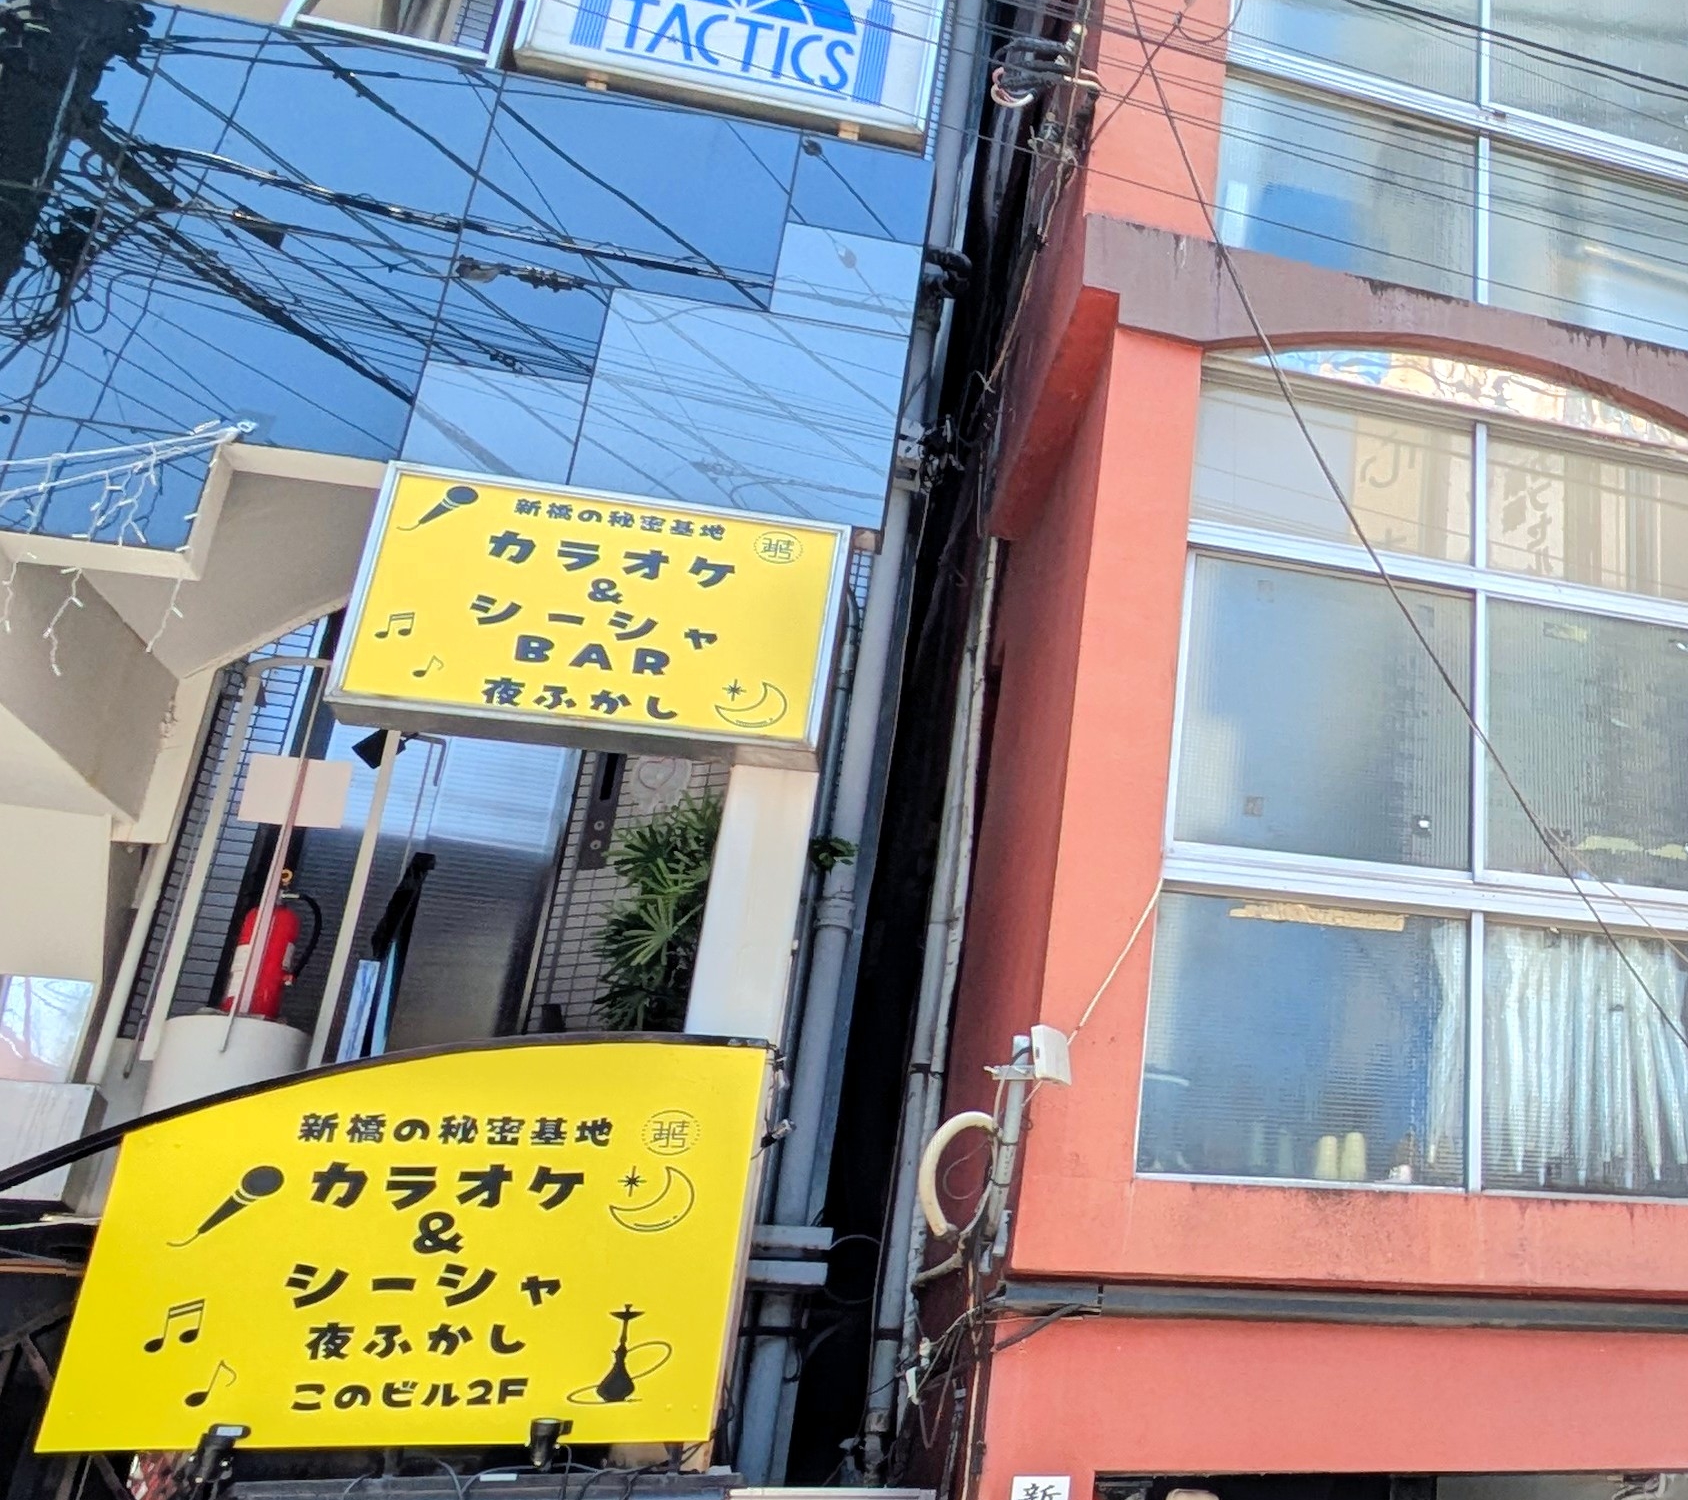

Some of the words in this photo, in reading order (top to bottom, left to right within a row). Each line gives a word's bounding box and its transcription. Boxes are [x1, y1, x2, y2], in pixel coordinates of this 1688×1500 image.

[513, 498, 727, 541] 新橋の秘密基地
[486, 530, 737, 588] カラオケ
[587, 578, 624, 604] &
[468, 594, 719, 651] シーシャ
[514, 634, 672, 677] BAR
[481, 677, 678, 721] 夜ふかし
[297, 1112, 615, 1149] 新橋の秘密基地
[310, 1161, 586, 1210] カラオケ
[412, 1211, 465, 1255] &
[283, 1264, 563, 1309] シーシャ
[305, 1322, 528, 1362] 夜ふかし
[289, 1377, 530, 1412] このビル2F
